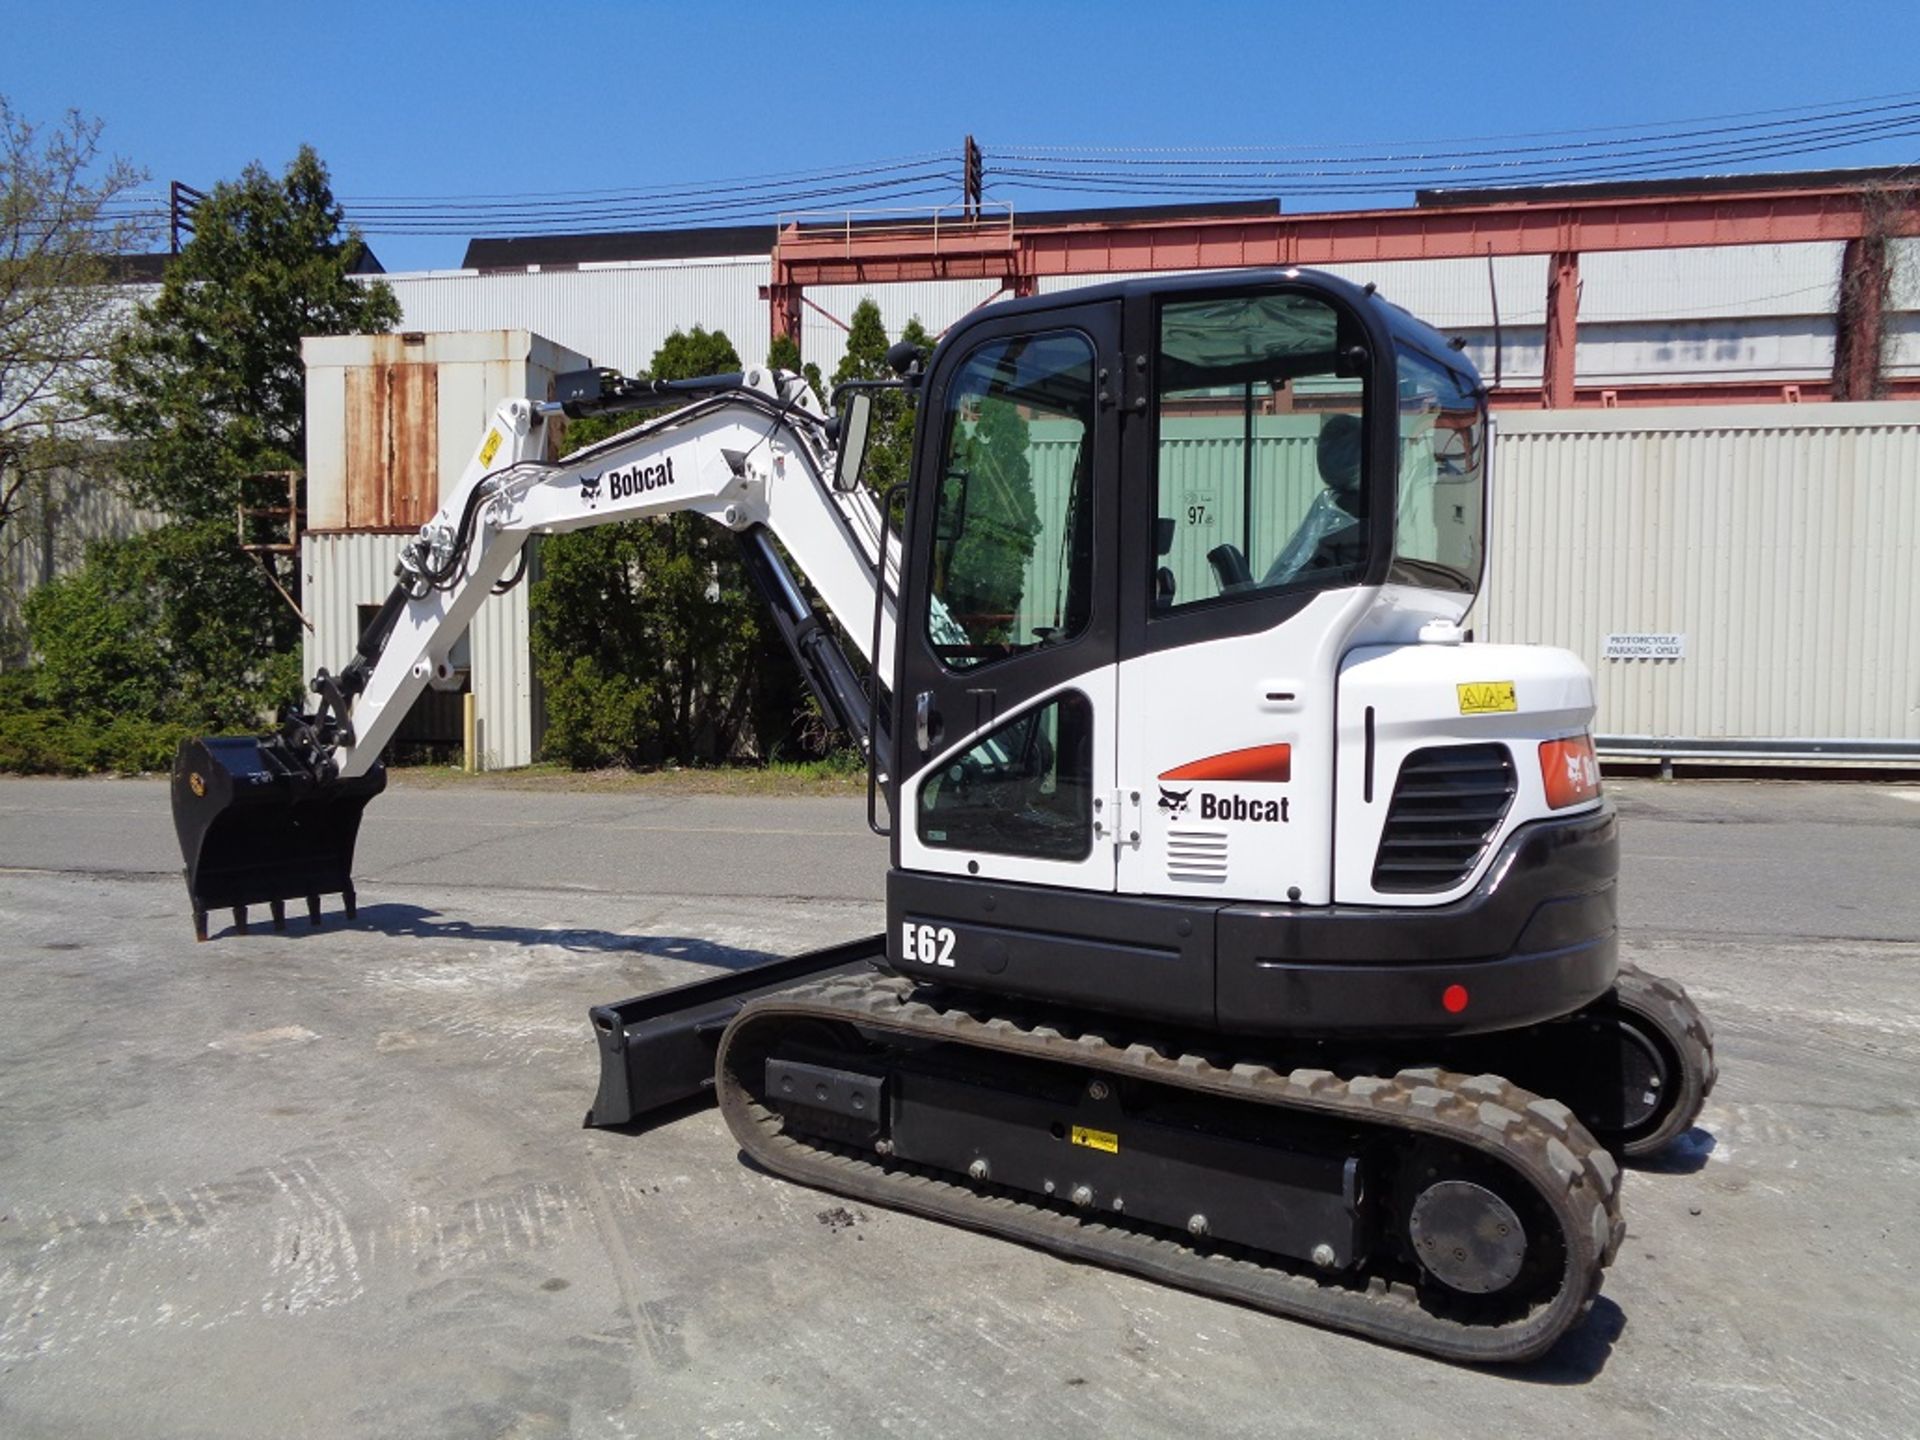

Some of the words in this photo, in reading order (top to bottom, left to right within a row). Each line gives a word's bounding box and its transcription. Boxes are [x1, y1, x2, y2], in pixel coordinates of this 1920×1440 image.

[609, 456, 675, 500] Bobcat
[1188, 506, 1205, 525] 97
[1606, 646, 1652, 655] PARKING
[1655, 646, 1681, 655] ONLY
[1610, 635, 1679, 645] MOTORCYCLE
[1200, 792, 1290, 823] Bobcat
[902, 921, 956, 968] E62
